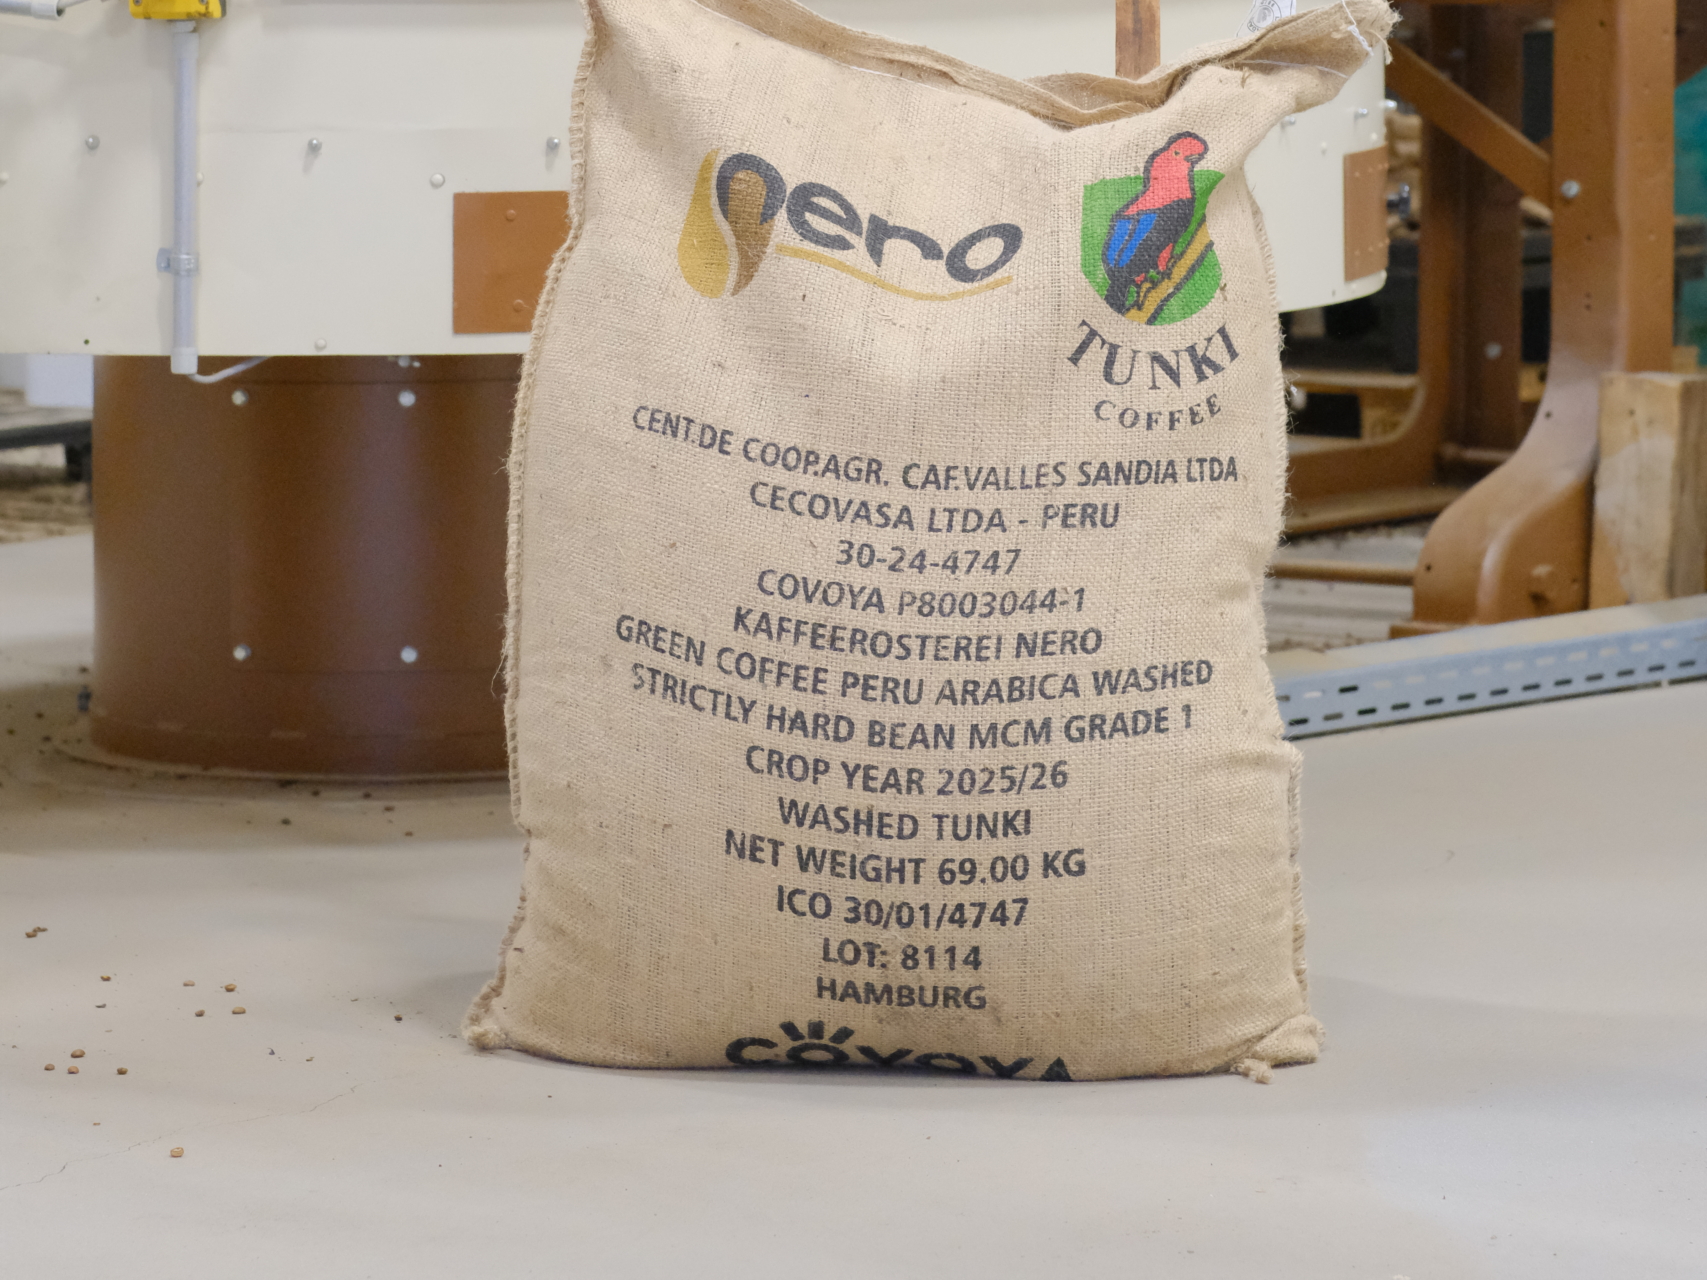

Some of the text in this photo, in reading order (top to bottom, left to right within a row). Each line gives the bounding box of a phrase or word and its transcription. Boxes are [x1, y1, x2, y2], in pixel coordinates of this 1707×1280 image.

[1067, 319, 1240, 390] TUNKI
[1094, 393, 1221, 431] COFFEE
[1078, 459, 1178, 486] SANDIA
[1187, 456, 1238, 482] LTDA
[750, 481, 914, 531] CECOVASA
[928, 507, 1007, 533] LTDA
[1041, 503, 1120, 529] PERU
[836, 540, 1021, 575] 30-24-4747
[757, 569, 1085, 618] COVOYA P8003044-1
[734, 606, 1102, 662] KAFFEEROSTEREI NERO
[616, 614, 1213, 706] GREEN COFFEE PERU ARABICA WASHED
[632, 662, 1193, 750] STRICTLY HARD BEAN MCM GRADE 1
[746, 745, 1068, 796] CROP YEAR 2025/26
[778, 796, 1032, 842] WASHED TUNKI
[725, 829, 1086, 886] NET WEIGHT 69.00 KG
[777, 885, 1029, 931] ICO 30/01/4747
[822, 937, 982, 971] LOT: 8114
[816, 976, 987, 1010] HAMBURG
